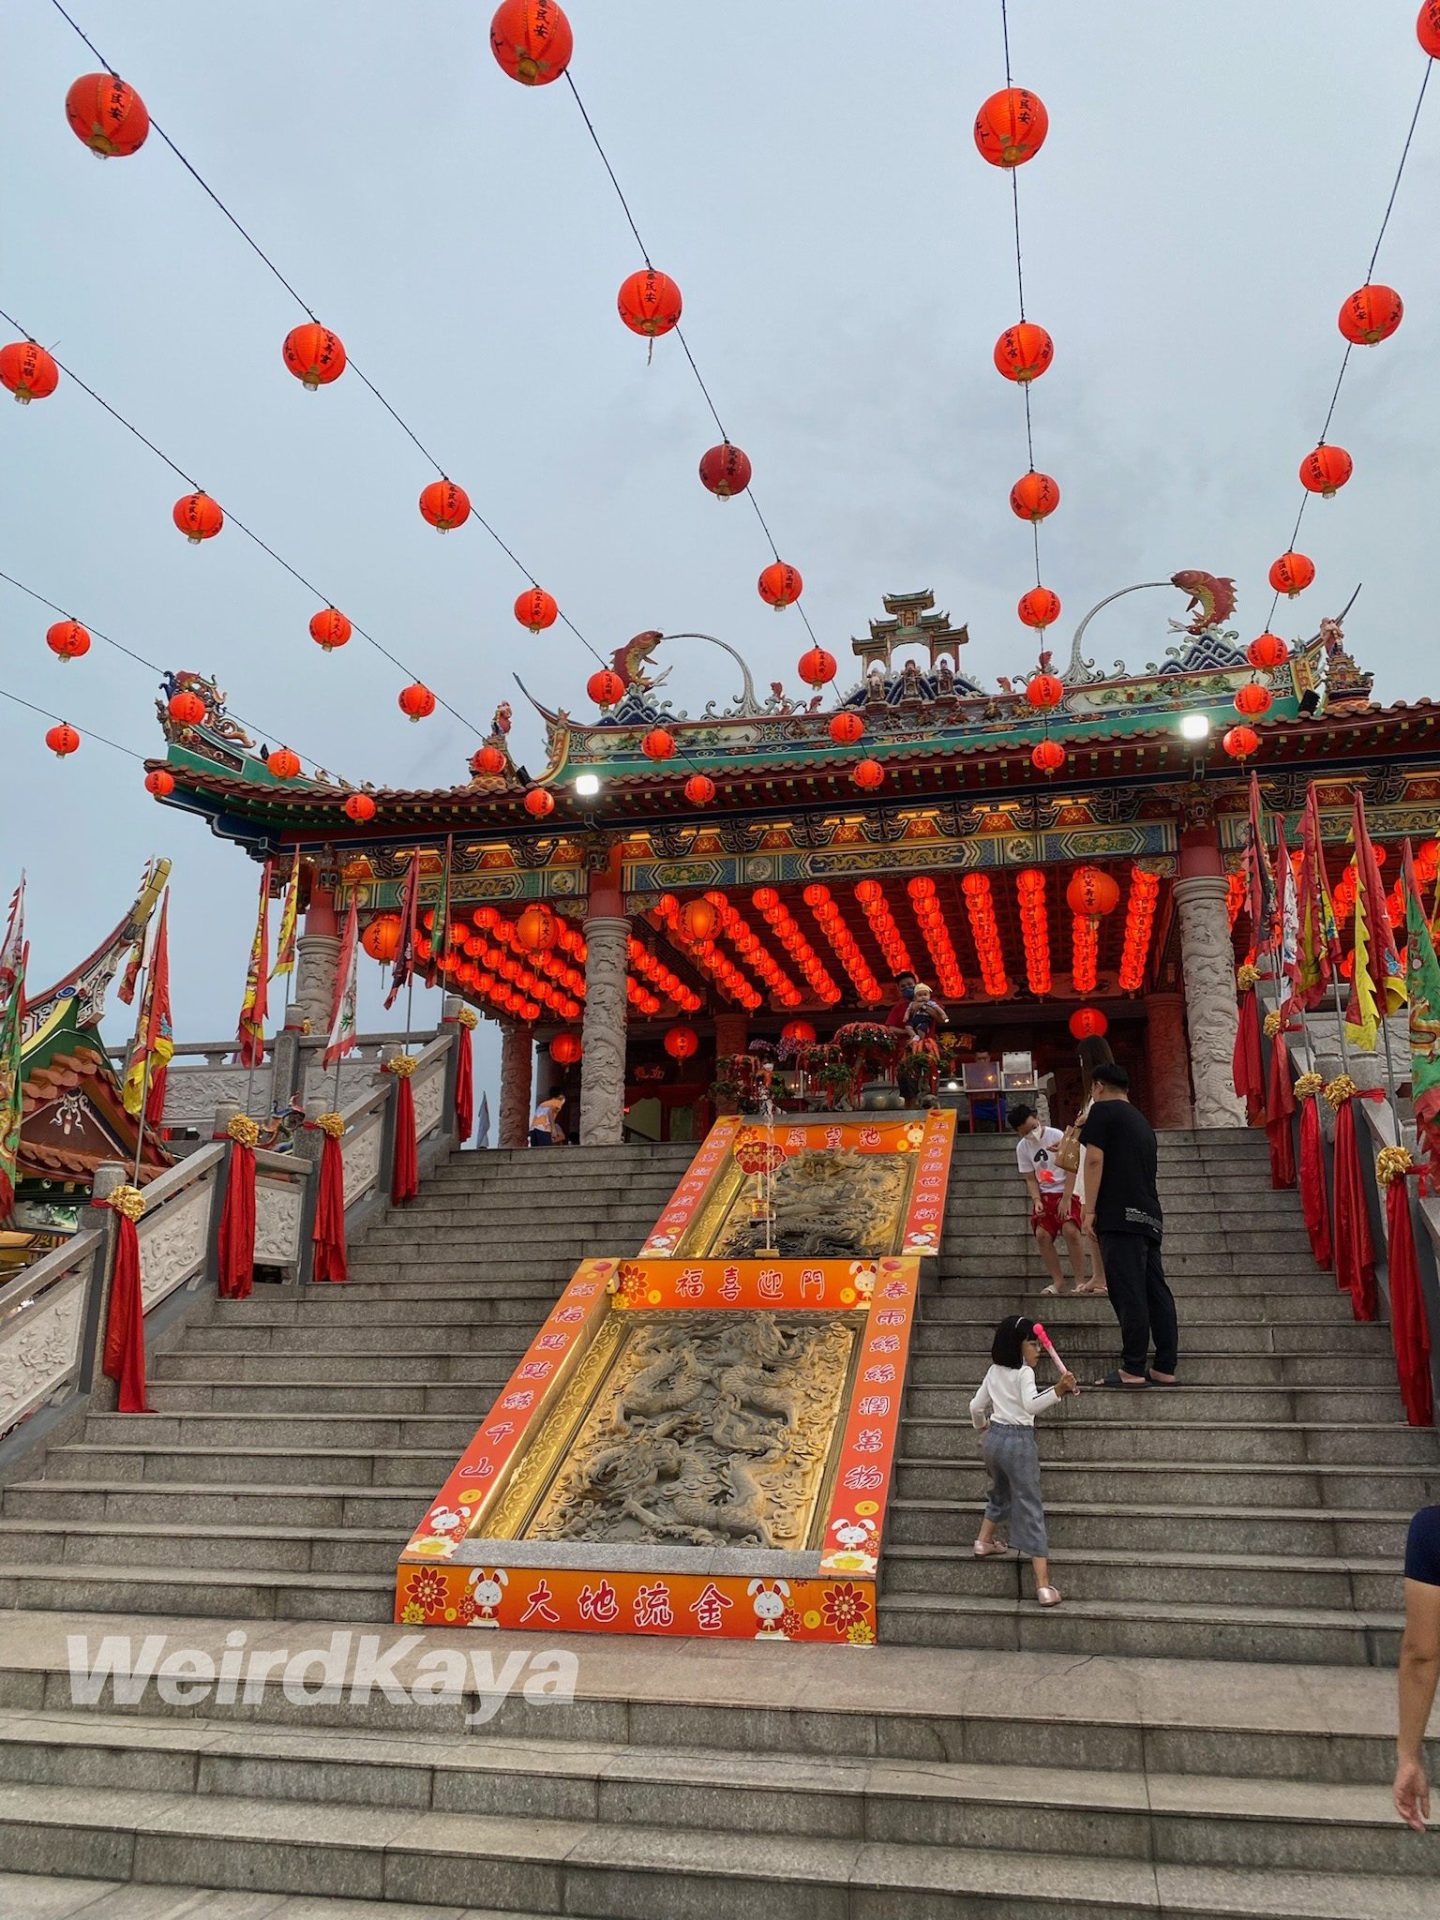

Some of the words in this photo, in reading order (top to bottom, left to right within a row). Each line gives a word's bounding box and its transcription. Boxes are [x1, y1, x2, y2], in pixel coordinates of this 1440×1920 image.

[675, 1265, 825, 1301] 福喜迎門
[842, 1280, 912, 1491] 春雨絲絲潤萬物
[519, 1578, 733, 1630] 大地流金
